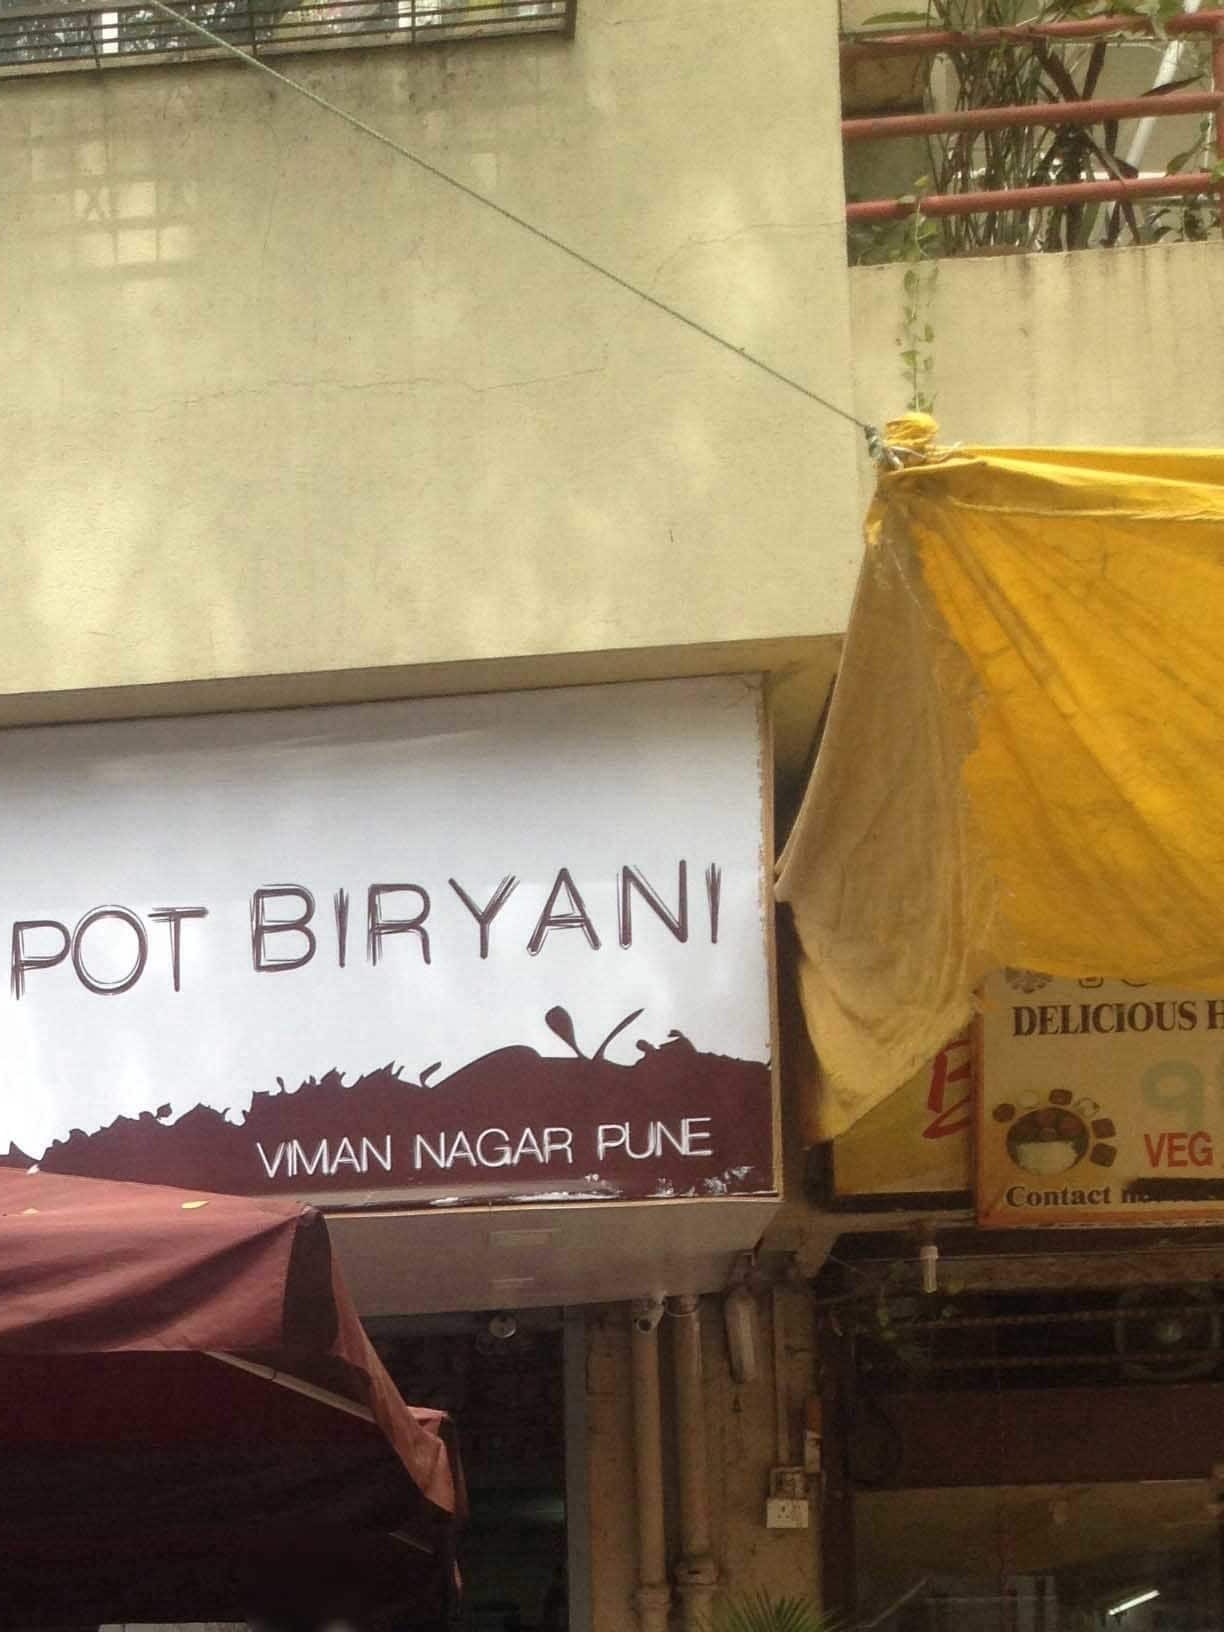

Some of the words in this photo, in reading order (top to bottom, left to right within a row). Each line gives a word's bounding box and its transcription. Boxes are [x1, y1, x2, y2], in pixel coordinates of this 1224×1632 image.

[10, 904, 209, 999] POT
[249, 859, 723, 972] BIRYANI
[1011, 1000, 1198, 1037] DELICIOUS
[256, 1135, 392, 1178] VIMAN
[415, 1127, 574, 1169] NAGAR
[597, 1117, 713, 1160] PUNE
[1143, 1130, 1214, 1168] VEG
[1006, 1185, 1111, 1207] Contact
